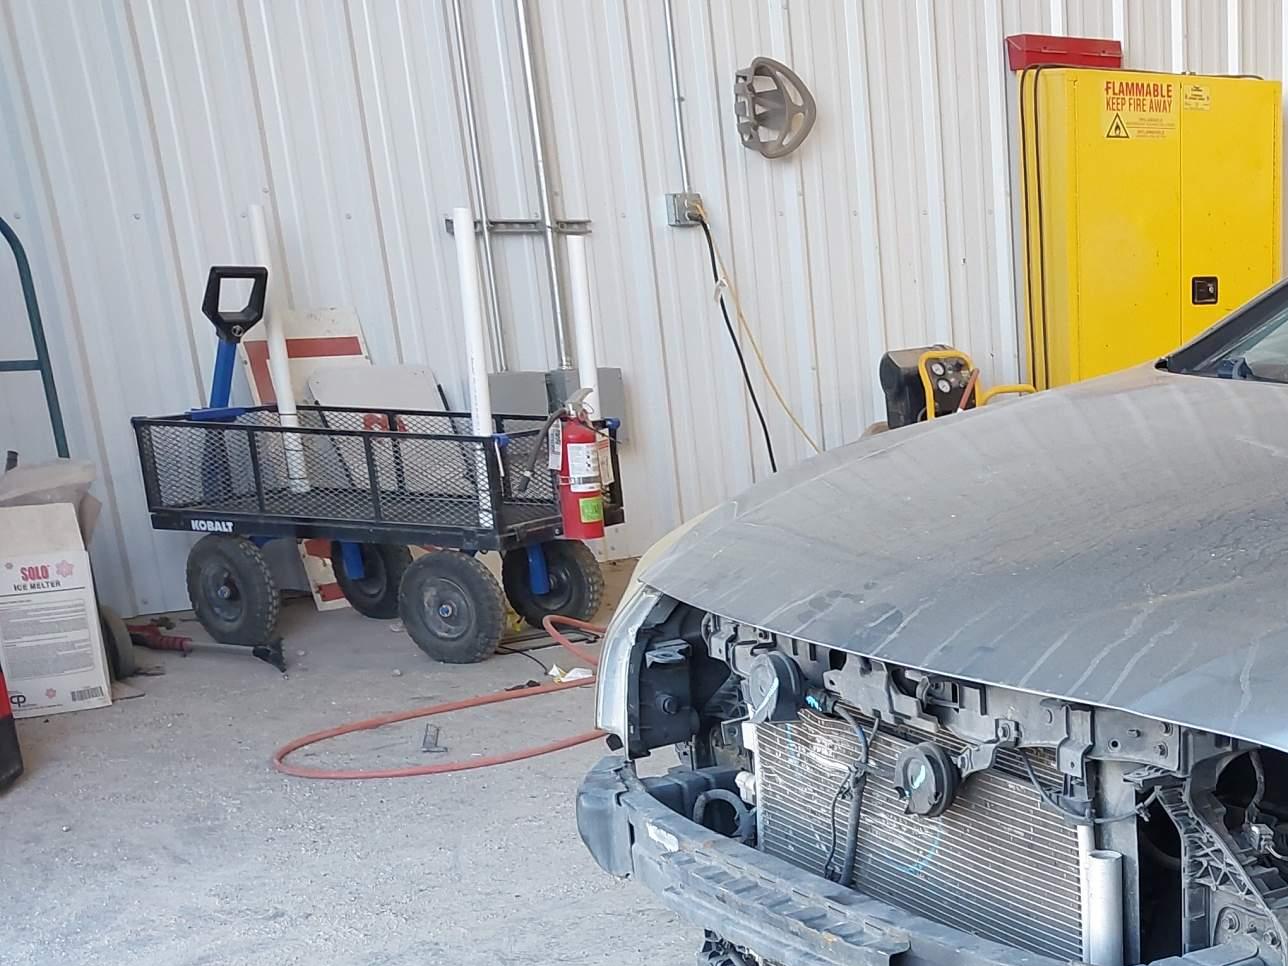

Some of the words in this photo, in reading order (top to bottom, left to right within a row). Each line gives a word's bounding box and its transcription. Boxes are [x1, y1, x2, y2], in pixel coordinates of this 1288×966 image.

[1105, 80, 1172, 98] FLAMMABLE
[1106, 96, 1126, 112] KEEP
[1128, 97, 1146, 112] FIRE
[1149, 98, 1172, 113] AWAY
[191, 519, 233, 533] KOBALT
[13, 583, 28, 592] ICE
[30, 579, 61, 591] MELTER
